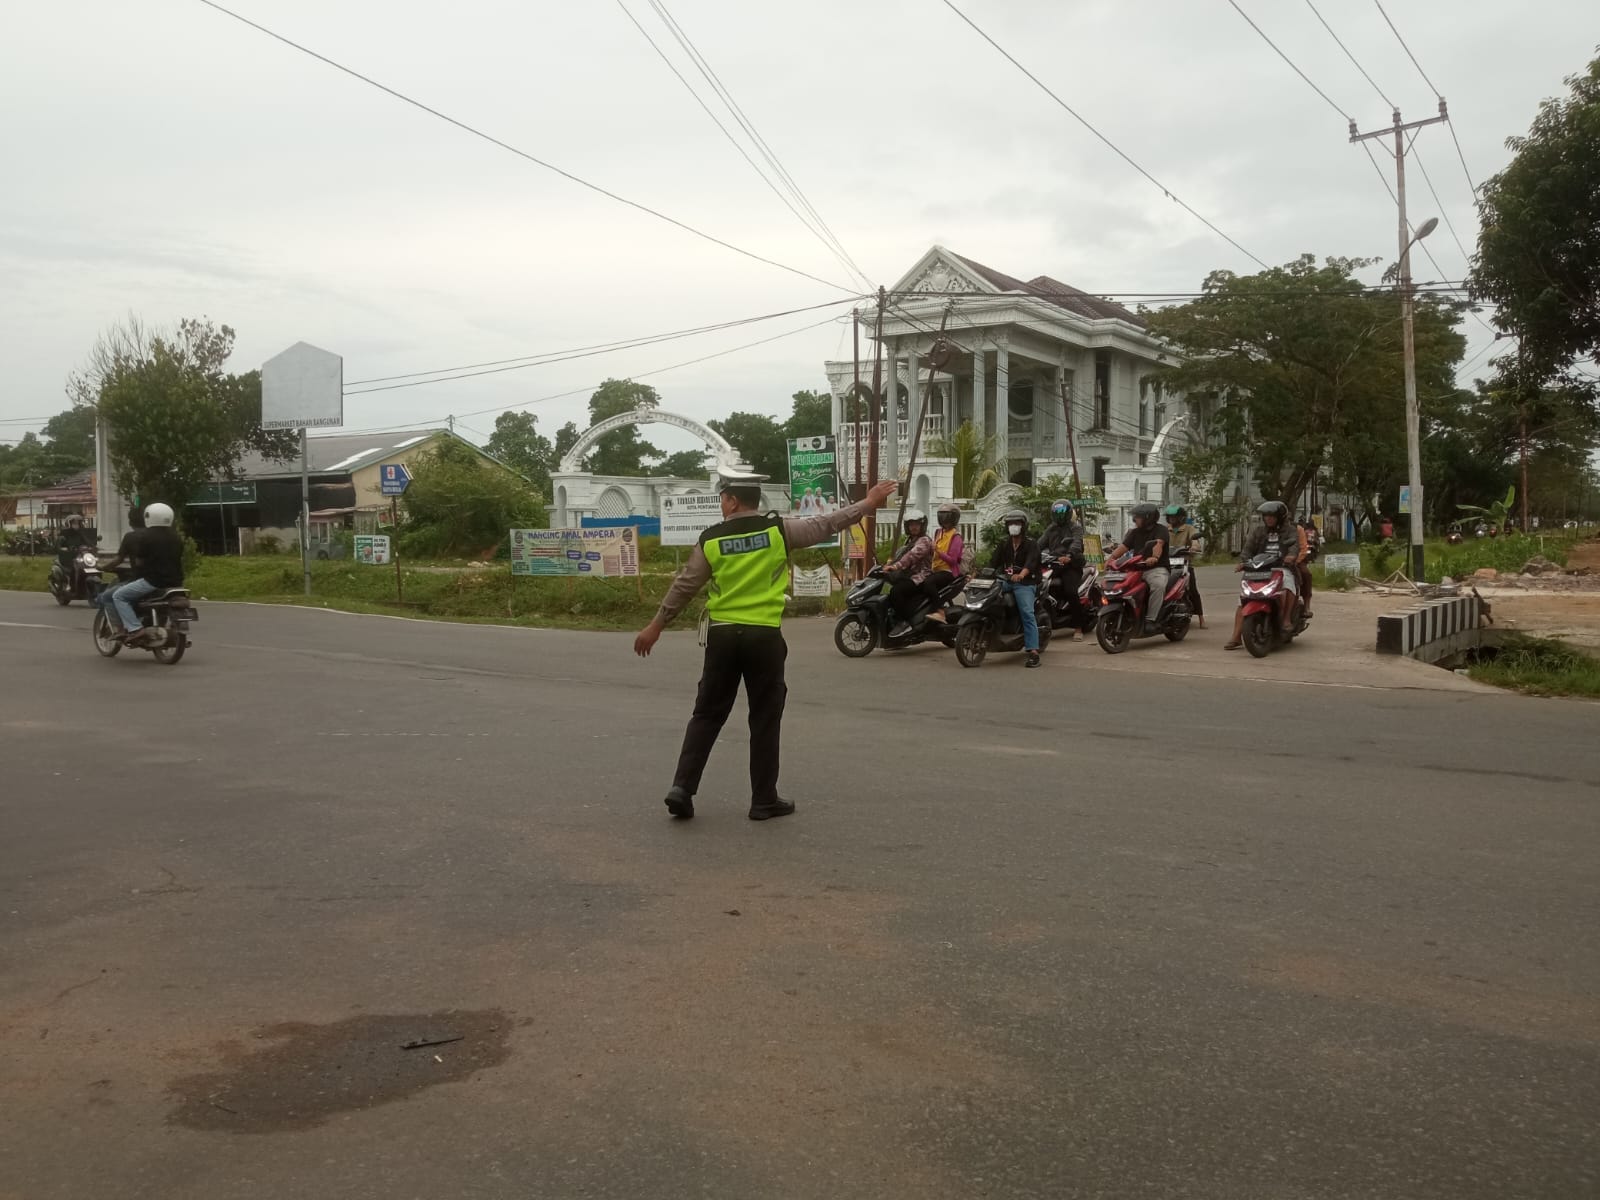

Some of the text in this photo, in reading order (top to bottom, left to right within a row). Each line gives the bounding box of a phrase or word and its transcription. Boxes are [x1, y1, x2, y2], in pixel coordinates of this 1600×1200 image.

[562, 531, 581, 539] AMAL
[583, 529, 615, 539] AMPERA
[722, 533, 769, 554] POLISI
